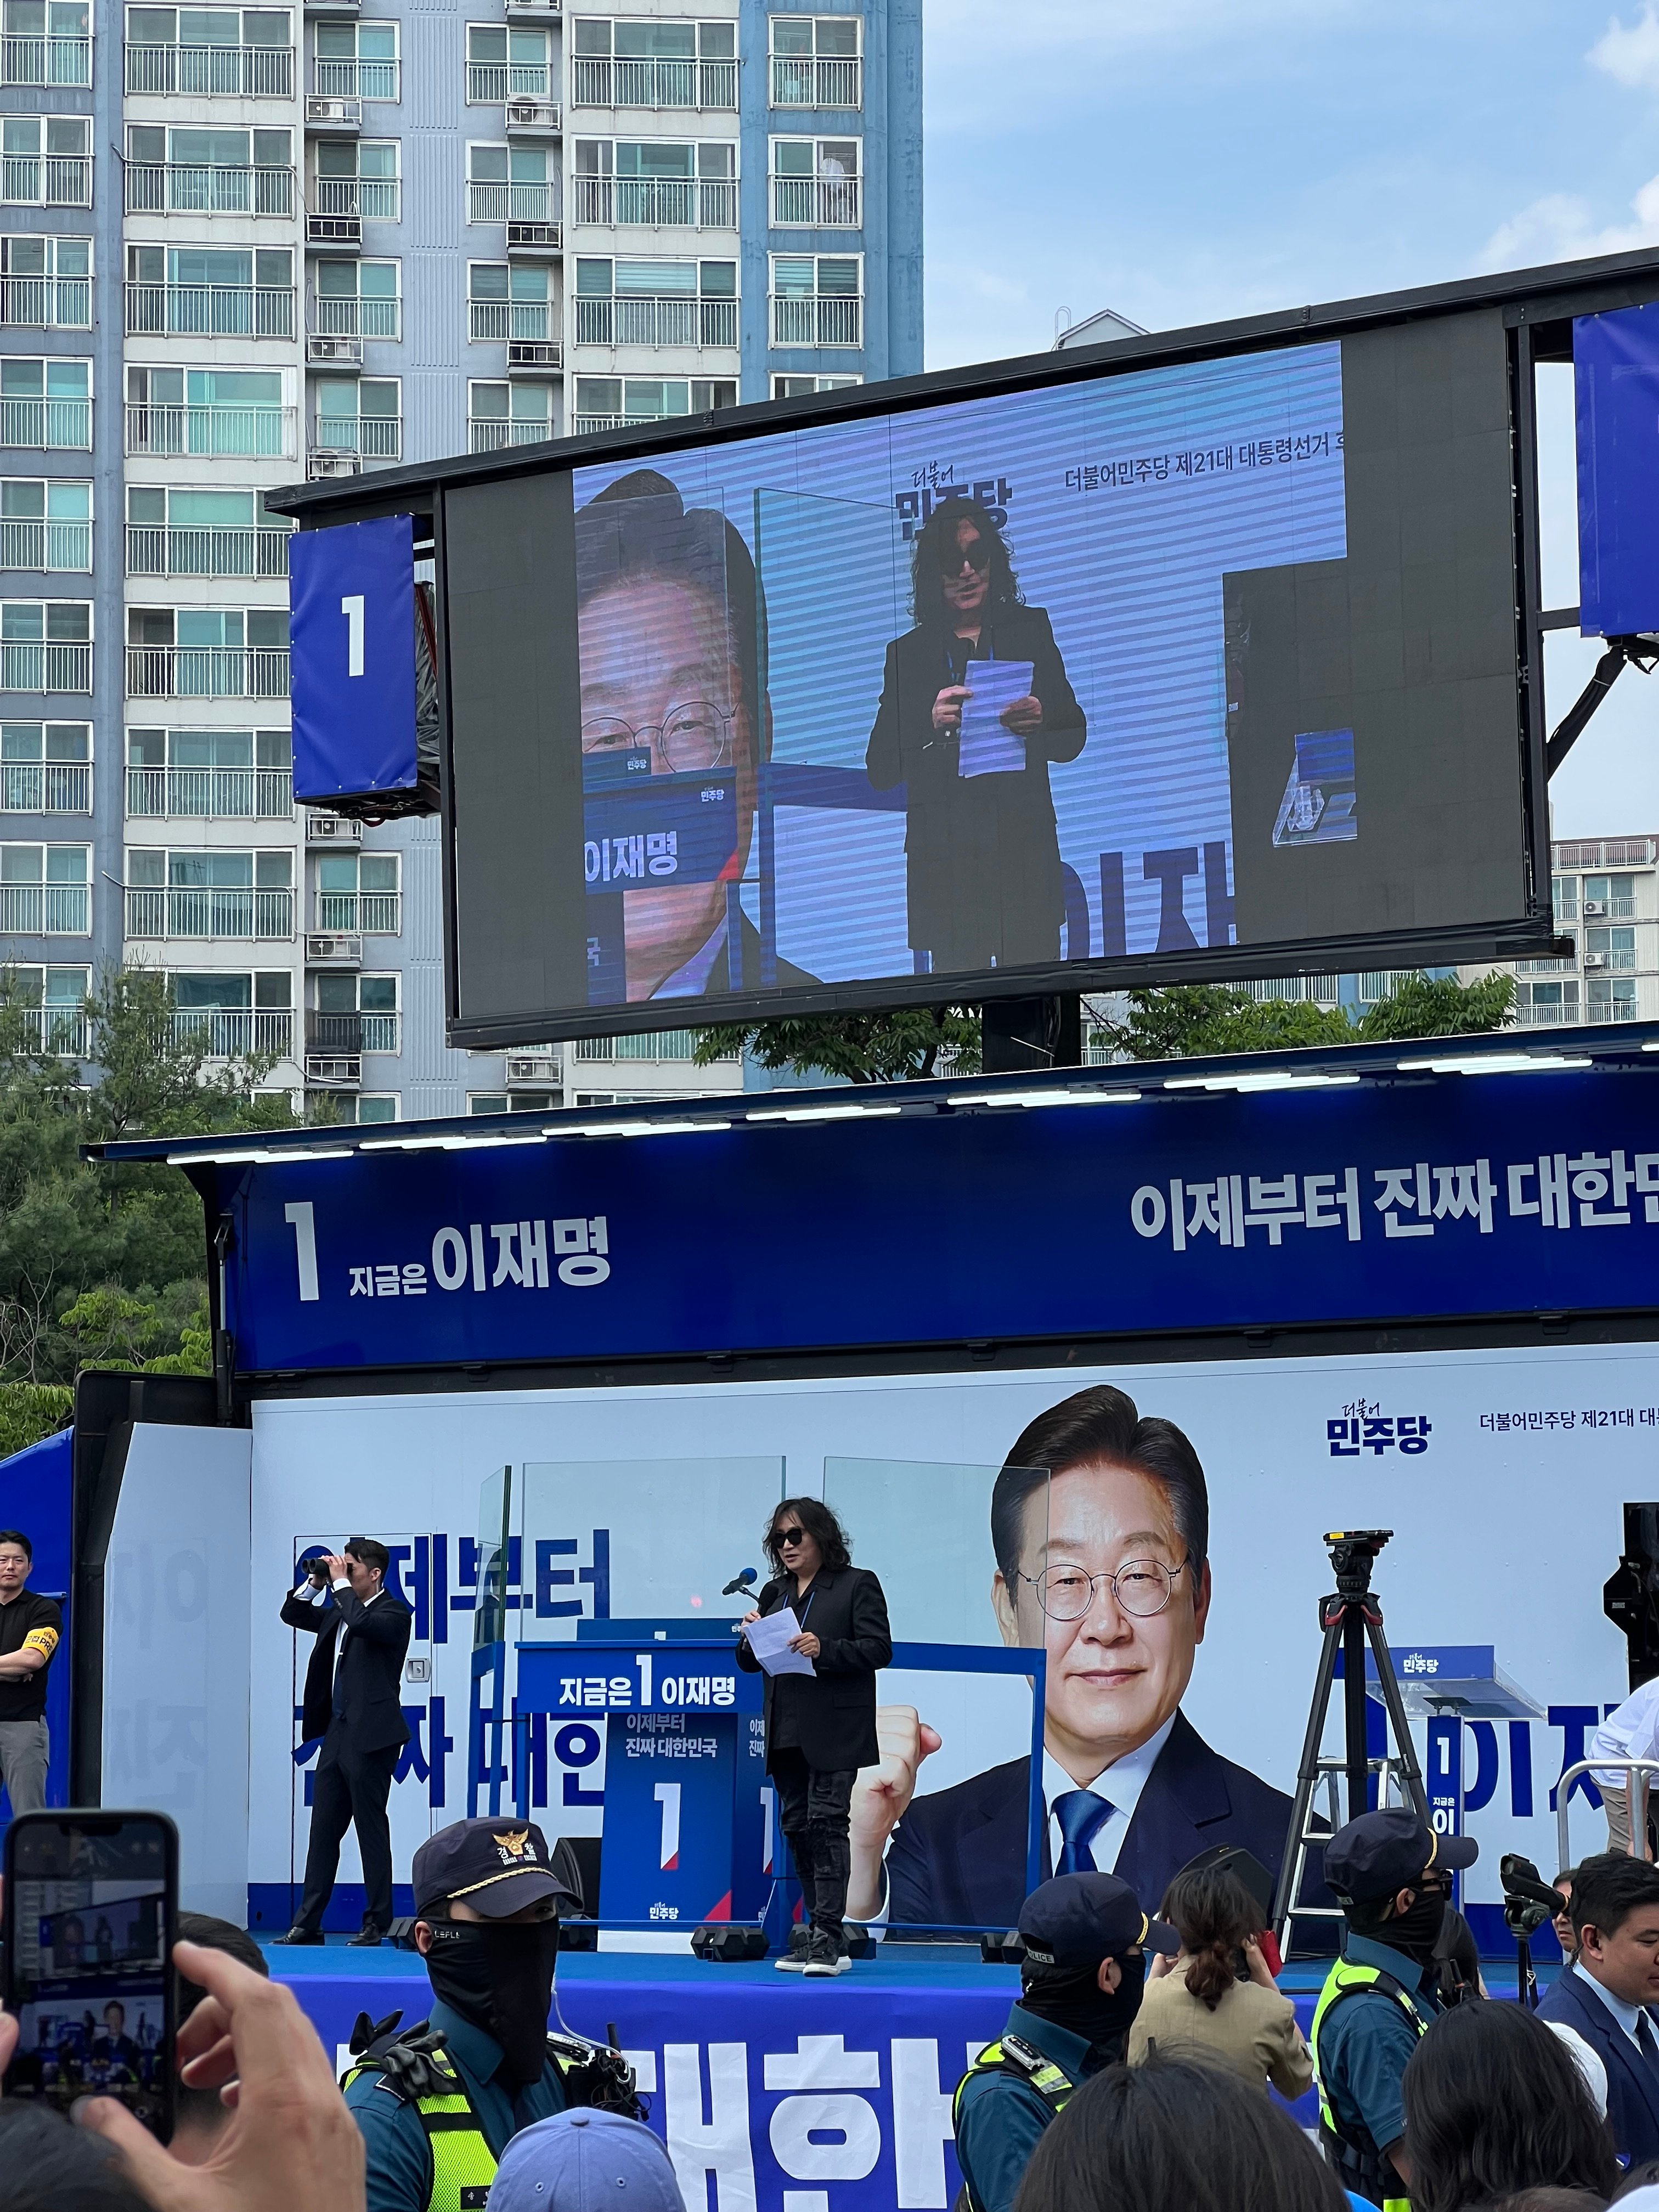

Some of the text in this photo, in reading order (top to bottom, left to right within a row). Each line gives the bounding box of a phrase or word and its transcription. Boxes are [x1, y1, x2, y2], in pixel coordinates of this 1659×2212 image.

[911, 460, 953, 489] 더불어
[1065, 454, 1170, 492] 더불어민주당
[1176, 445, 1233, 476] 제21대
[1240, 431, 1329, 467] 대통령선거
[341, 595, 365, 676] 1
[701, 789, 725, 803] 민주당
[584, 831, 678, 882] 이재명
[1131, 1167, 1361, 1251] 이제부터
[1374, 1159, 1497, 1238] 진짜
[285, 1201, 610, 1301] 1 지금은 이재명
[1342, 1398, 1380, 1420] 더불어
[1480, 1407, 1659, 1432] 더불어민주당 제21대 대
[1327, 1416, 1432, 1456] 민주당
[559, 1655, 735, 1706] 지금은 1 이재명
[1403, 1660, 1438, 1673] 민주당
[627, 1713, 685, 1733] 이제부터
[625, 1737, 718, 1758] 진짜 대한민국
[1437, 1737, 1449, 1774] 1
[1433, 1797, 1454, 1806] 지금은
[654, 1783, 681, 1870] 1
[650, 1907, 679, 1920] 민주당
